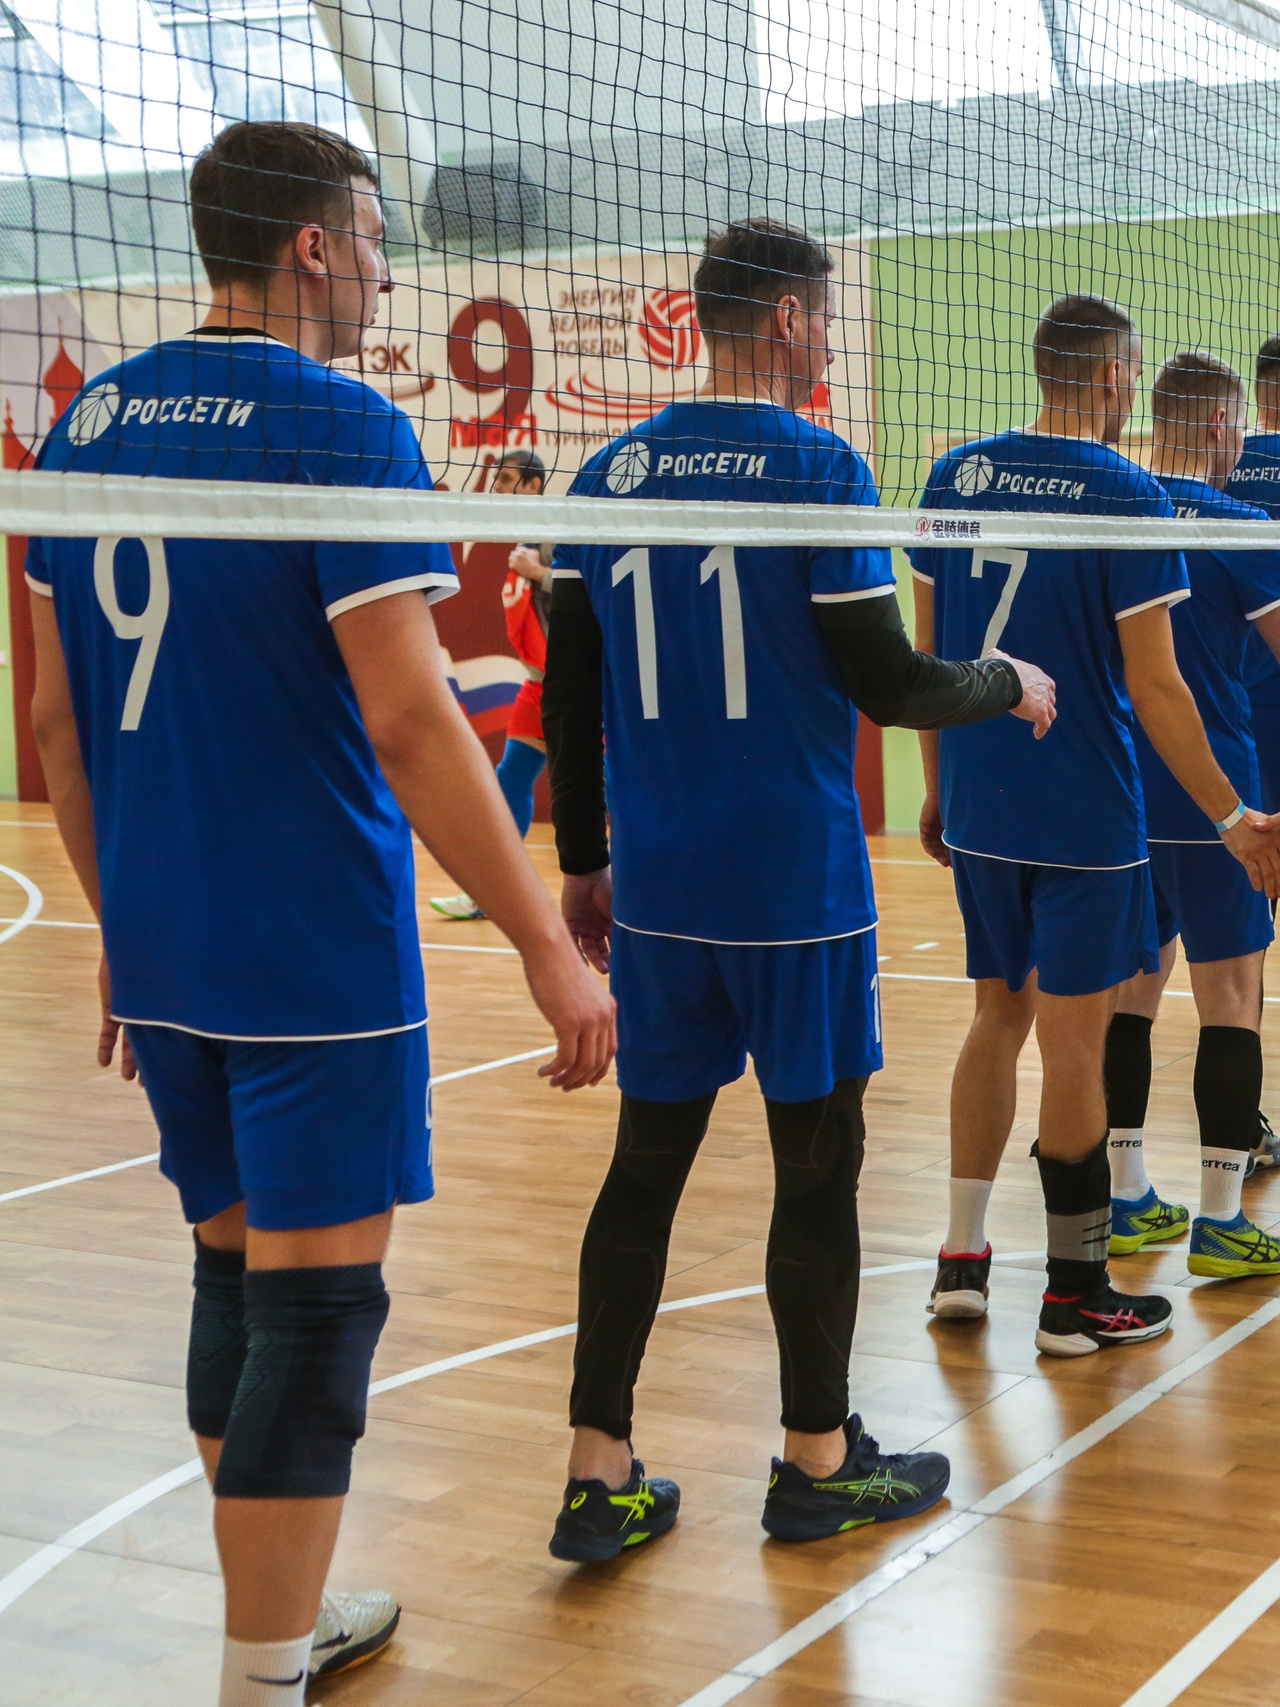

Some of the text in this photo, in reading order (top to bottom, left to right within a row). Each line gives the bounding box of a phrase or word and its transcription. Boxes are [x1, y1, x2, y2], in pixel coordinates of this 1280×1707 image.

[558, 288, 635, 309] ЭНЕРГИЯ
[448, 296, 533, 426] 9
[120, 396, 255, 427] РОССЕТИ
[656, 452, 767, 478] РОССЕТИ
[996, 471, 1085, 500] РОССЕТИ
[932, 520, 981, 535] 金陵体育
[971, 548, 1028, 659] 7
[94, 537, 169, 731] 9
[612, 546, 748, 719] 11
